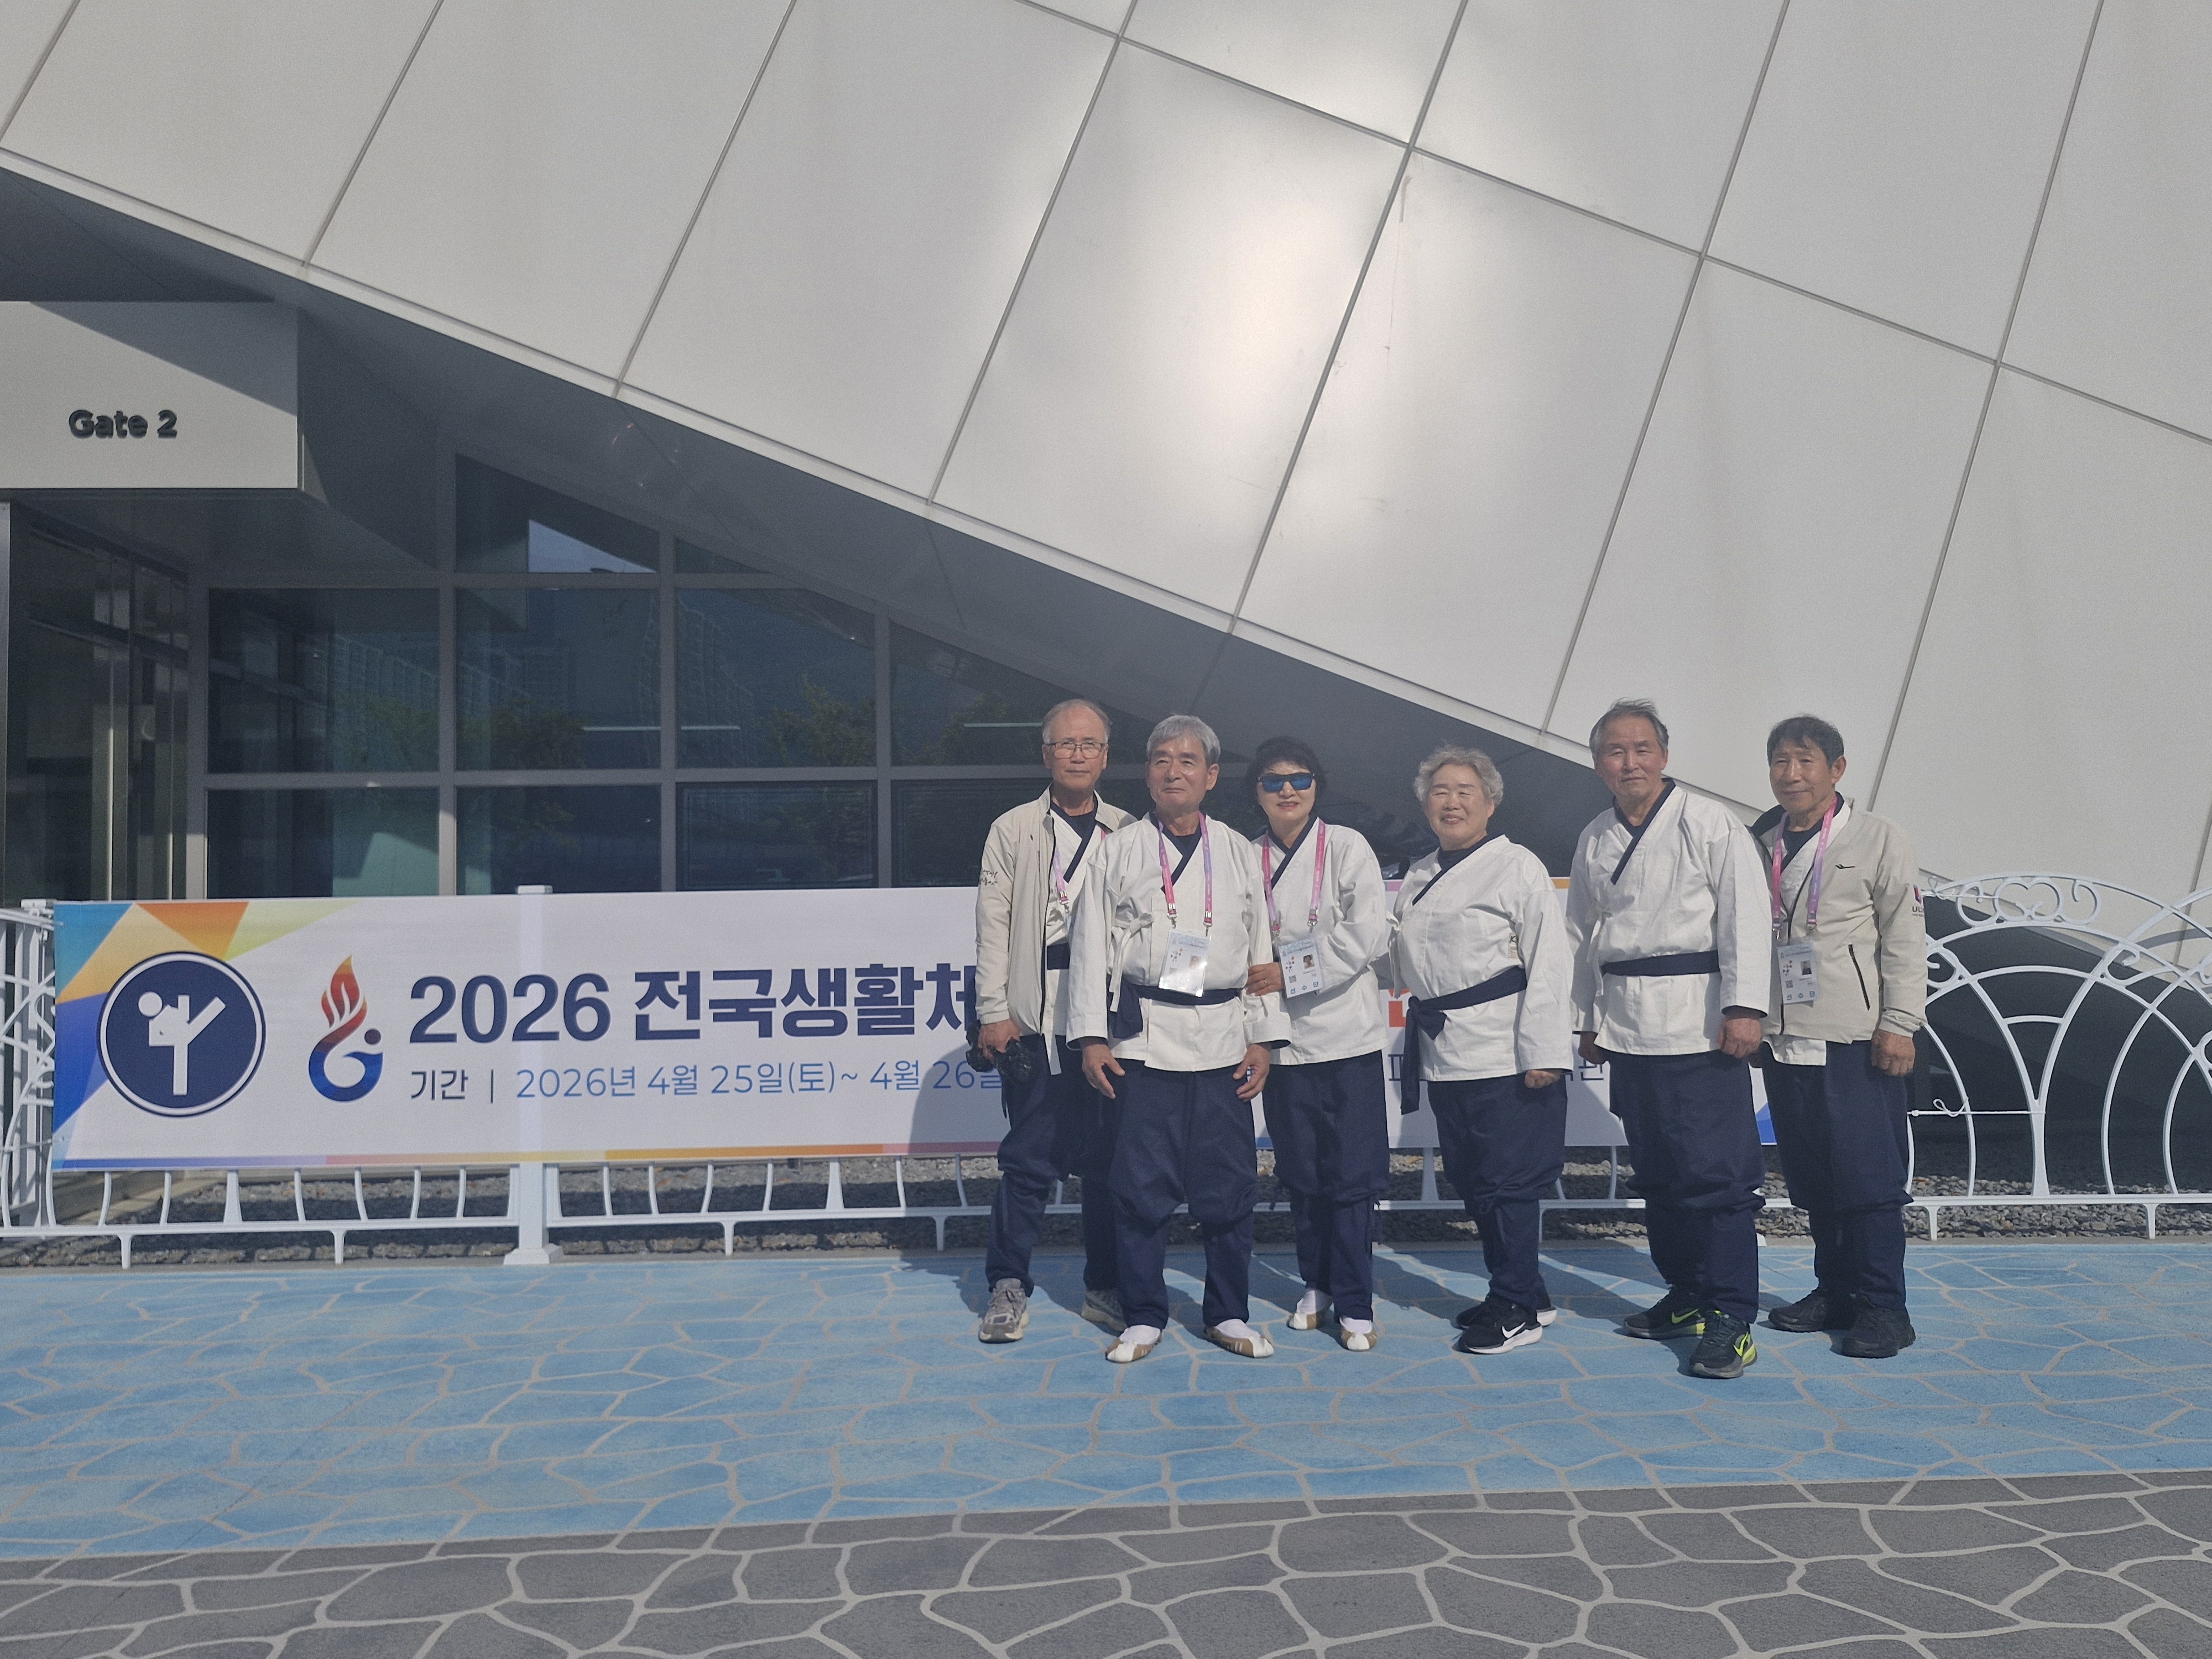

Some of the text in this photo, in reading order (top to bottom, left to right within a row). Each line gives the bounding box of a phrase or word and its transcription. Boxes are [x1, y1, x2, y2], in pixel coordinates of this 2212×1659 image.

[68, 409, 178, 439] Gate 2
[409, 973, 611, 1044] 2026
[411, 1070, 469, 1100] 기간
[517, 1065, 636, 1098] 2026년
[648, 1064, 698, 1096] 4월
[869, 1060, 920, 1091] 4월
